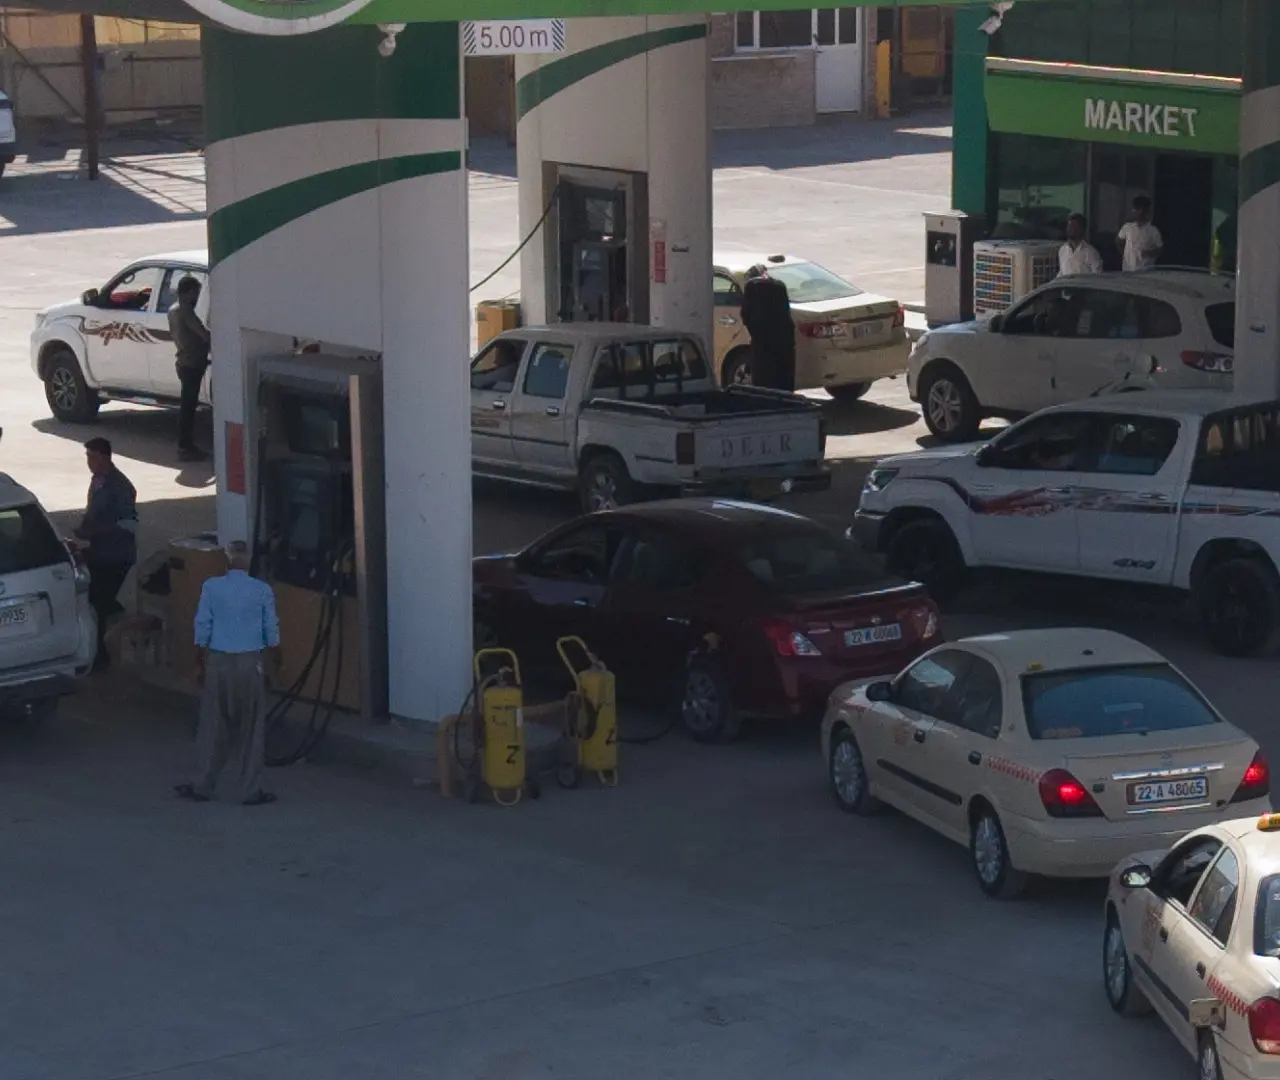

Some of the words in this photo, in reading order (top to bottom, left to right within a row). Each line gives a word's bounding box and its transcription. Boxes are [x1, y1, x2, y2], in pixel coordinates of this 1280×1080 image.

[481, 25, 525, 48] 5.00
[530, 29, 548, 47] m
[1084, 98, 1198, 137] MARKET
[721, 432, 792, 459] DEER
[1167, 779, 1204, 797] 48065
